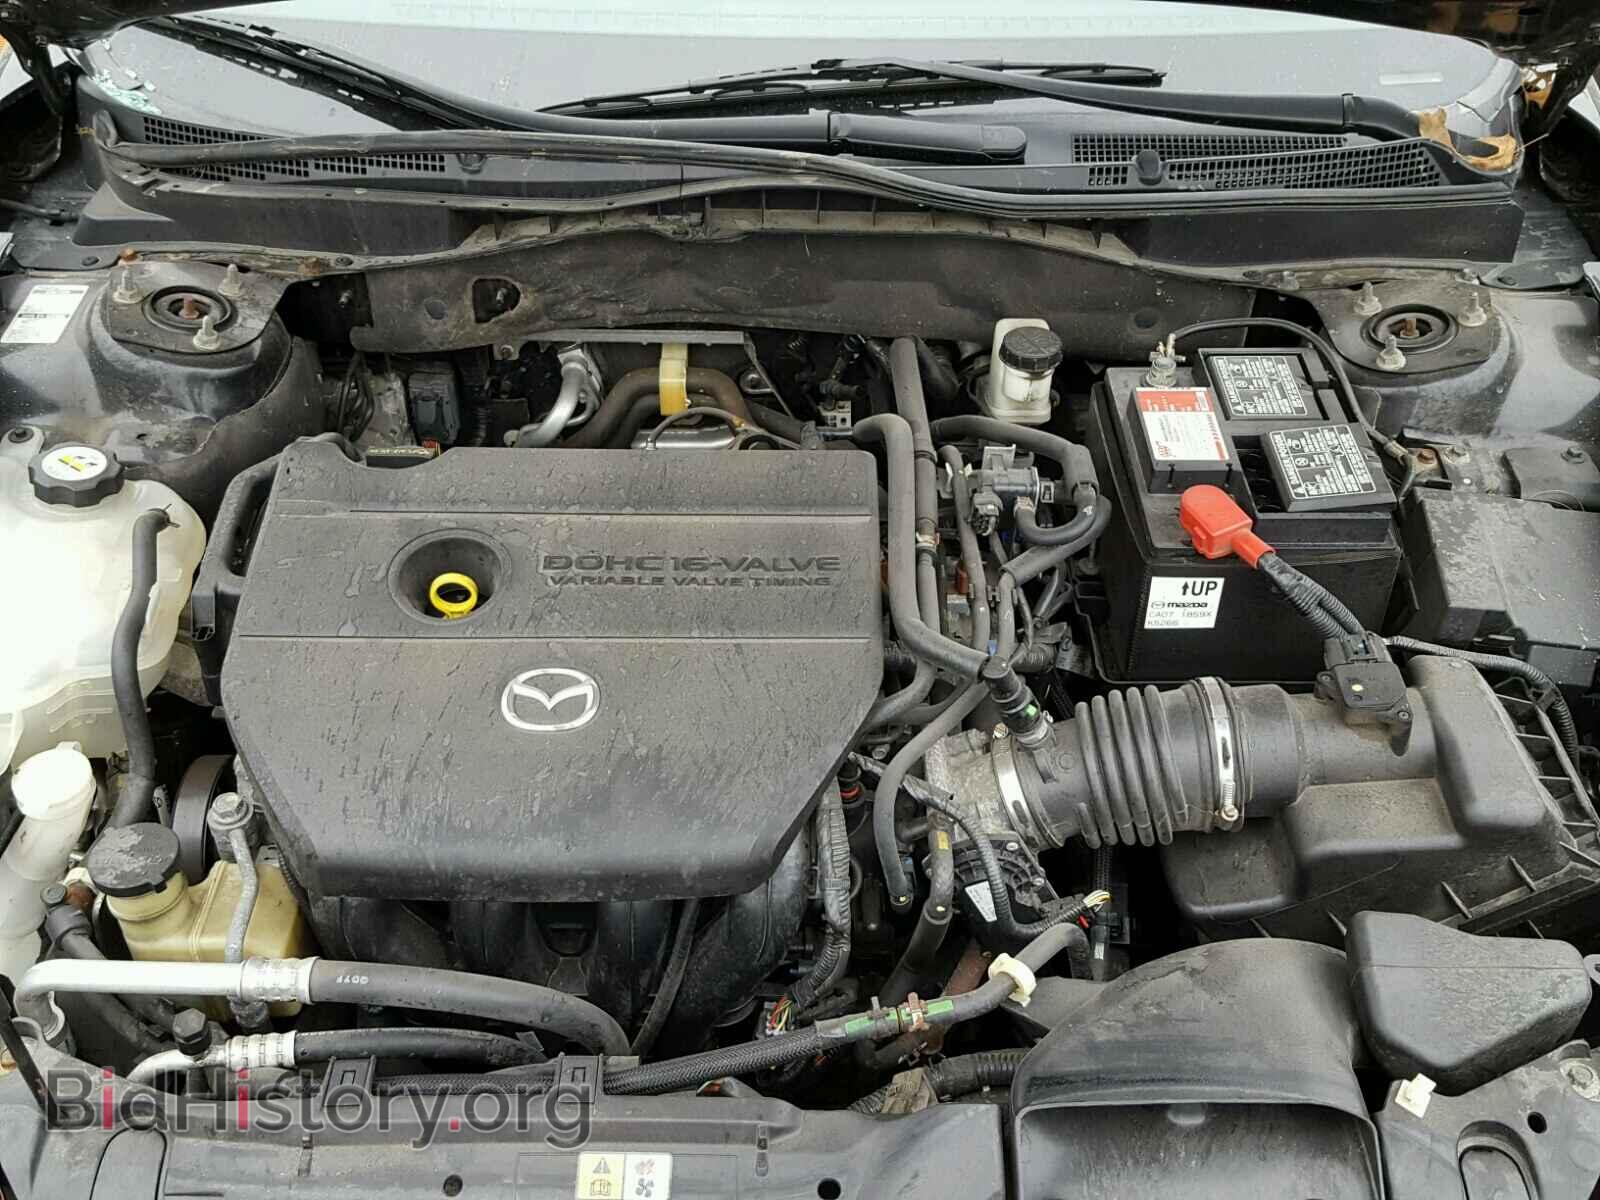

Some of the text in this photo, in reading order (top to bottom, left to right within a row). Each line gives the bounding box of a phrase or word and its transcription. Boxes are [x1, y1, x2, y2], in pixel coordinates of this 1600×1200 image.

[542, 555, 841, 572] DOHC 16-VALVE
[550, 576, 832, 587] VARIABLE VALVE TIMING
[1191, 580, 1218, 596] UP
